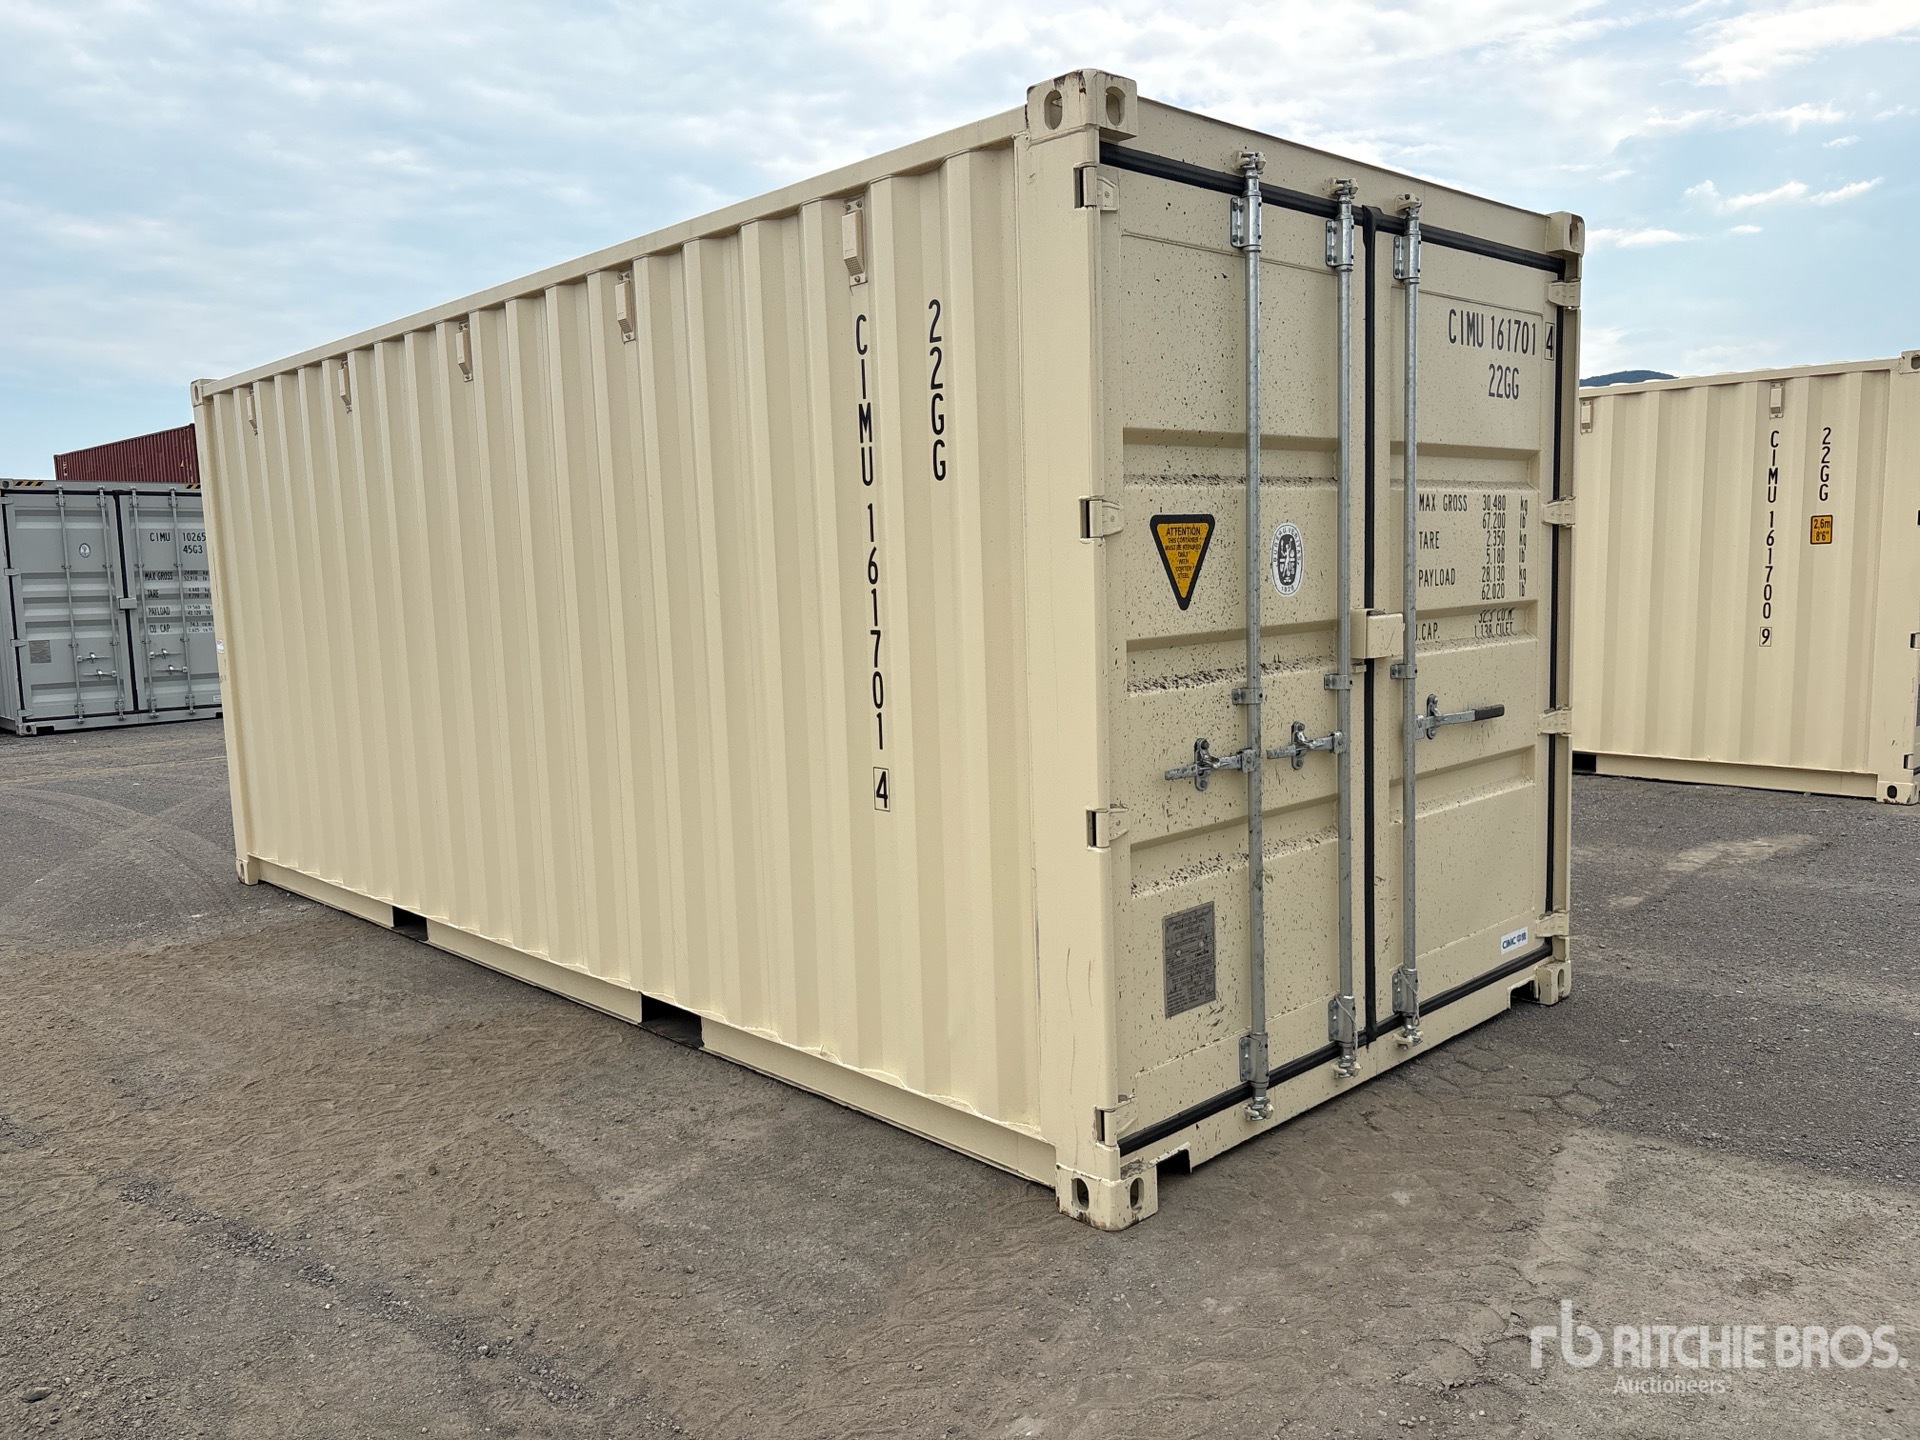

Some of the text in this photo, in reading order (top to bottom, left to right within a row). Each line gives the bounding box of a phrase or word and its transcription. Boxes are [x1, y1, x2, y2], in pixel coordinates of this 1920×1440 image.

[1449, 309, 1554, 358] CIMU 161701 4
[928, 299, 946, 481] 22GG
[1488, 363, 1520, 400] 22GG
[1819, 427, 1832, 501] 22GG
[1418, 493, 1528, 515] MAX GROSS 30.480 kg
[1482, 512, 1526, 529] 67.200 lb
[149, 532, 171, 542] CIMU
[1166, 527, 1201, 536] ATTENTION
[1418, 530, 1527, 550] TARE 2.350 kg
[1761, 430, 1780, 645] CIMU 161700 9
[183, 545, 203, 554] 45G3
[1486, 548, 1505, 565] 5.180
[855, 314, 889, 809] CIMU 161701 4
[1418, 565, 1526, 588] PAYLOAD 28.130 kg
[147, 589, 160, 599] TARE
[1481, 583, 1505, 600] 62.020
[148, 606, 171, 616] PAYLOAD
